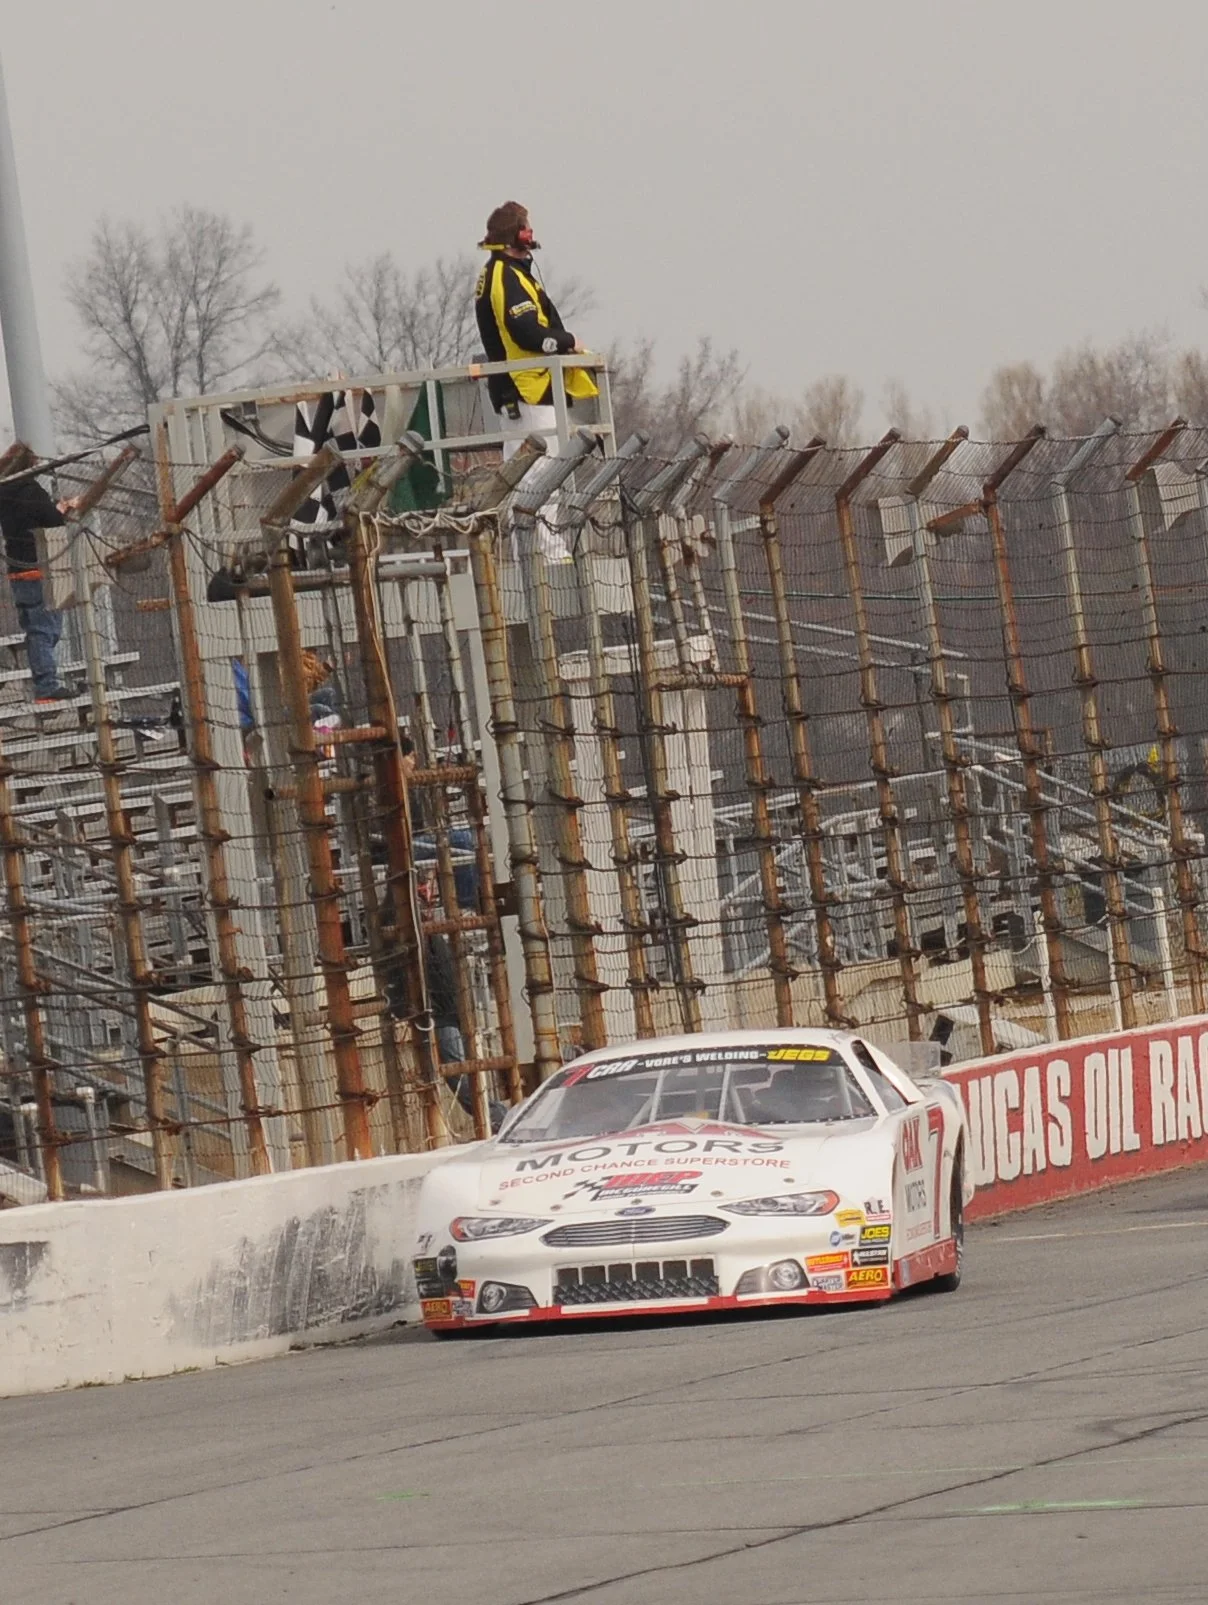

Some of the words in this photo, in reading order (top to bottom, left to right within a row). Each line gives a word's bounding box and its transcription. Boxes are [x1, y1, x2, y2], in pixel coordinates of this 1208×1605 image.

[695, 1051, 759, 1062] WELDING
[767, 1049, 831, 1061] JEGS
[957, 1059, 1074, 1188] UCAS
[1083, 1046, 1141, 1160] OIL
[515, 1139, 785, 1172] MOTORS
[924, 1103, 945, 1239] 7
[498, 1168, 575, 1191] SECOND
[581, 1158, 659, 1173] CHANCE
[664, 1157, 791, 1169] SUPERSTORE
[848, 1269, 883, 1282] AERO
